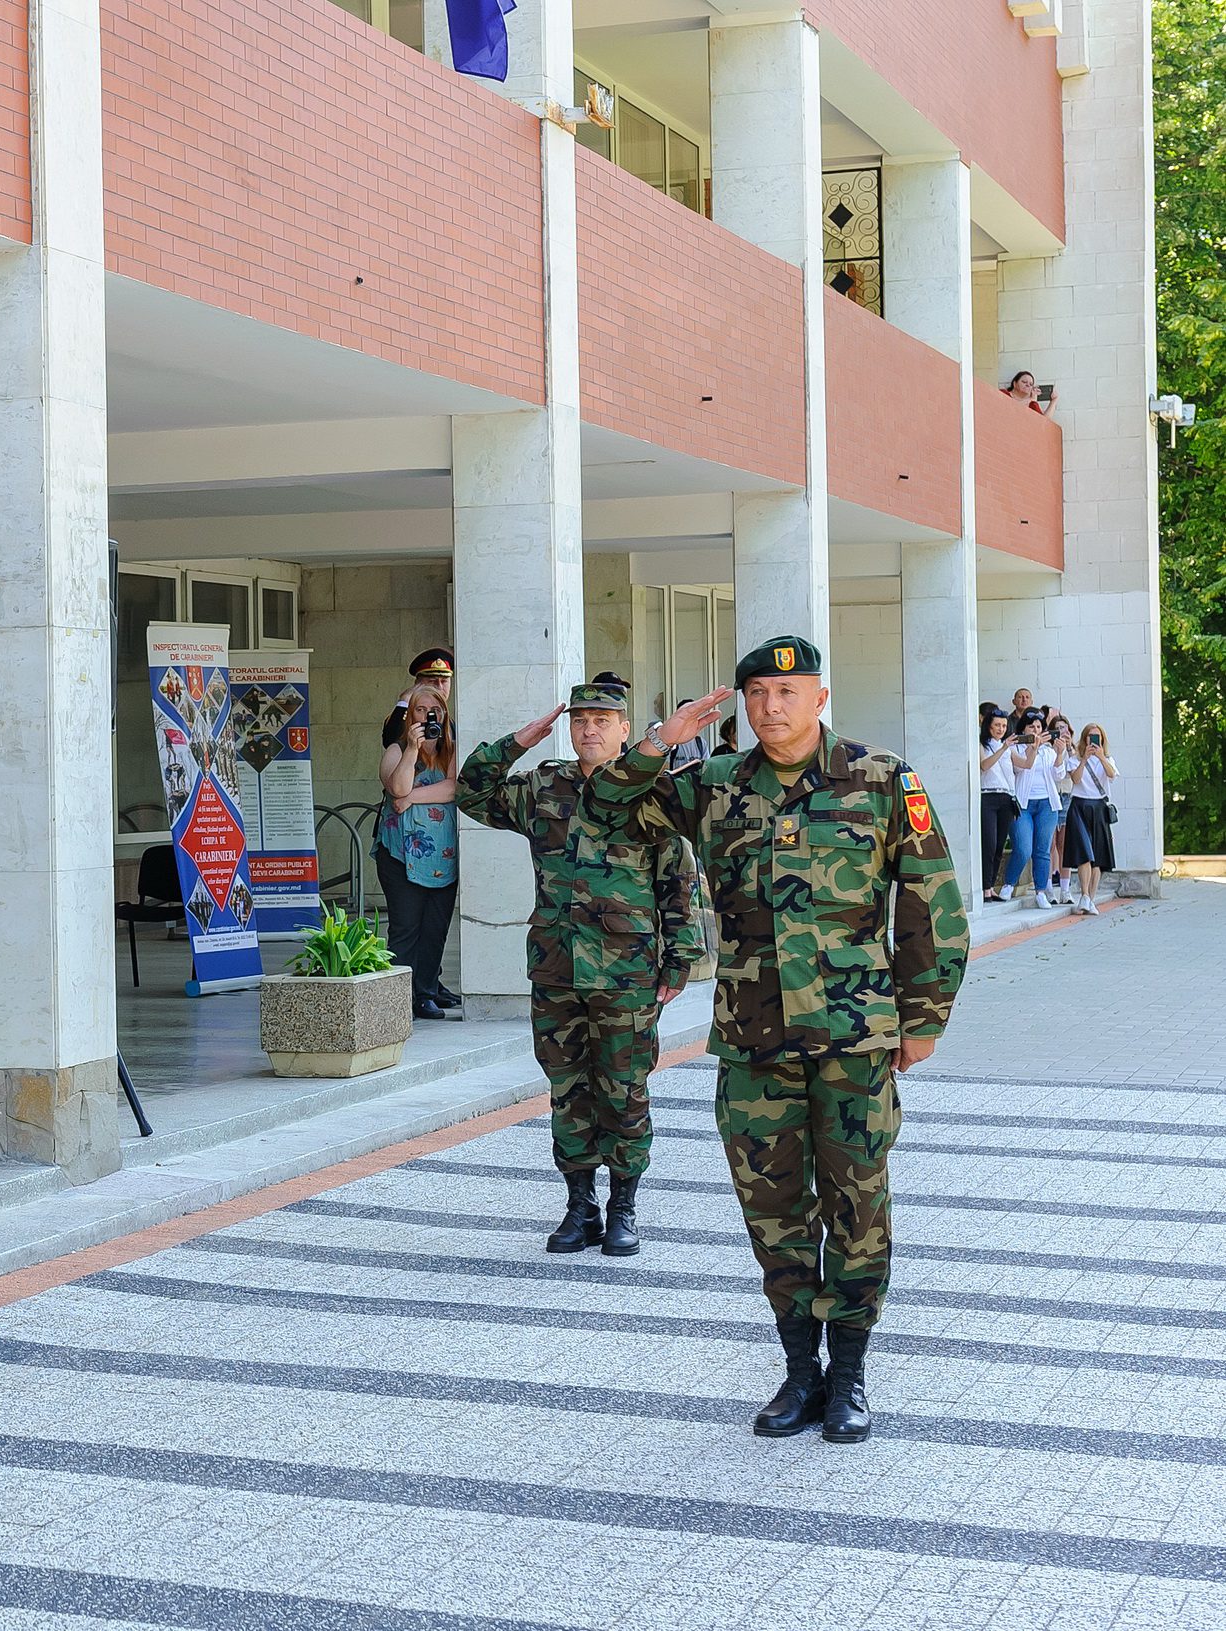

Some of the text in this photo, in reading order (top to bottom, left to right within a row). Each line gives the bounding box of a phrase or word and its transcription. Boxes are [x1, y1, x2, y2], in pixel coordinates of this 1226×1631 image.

[153, 643, 225, 653] INSPECTORATUL GENERAL
[170, 653, 180, 661] DE
[219, 836, 226, 844] DE
